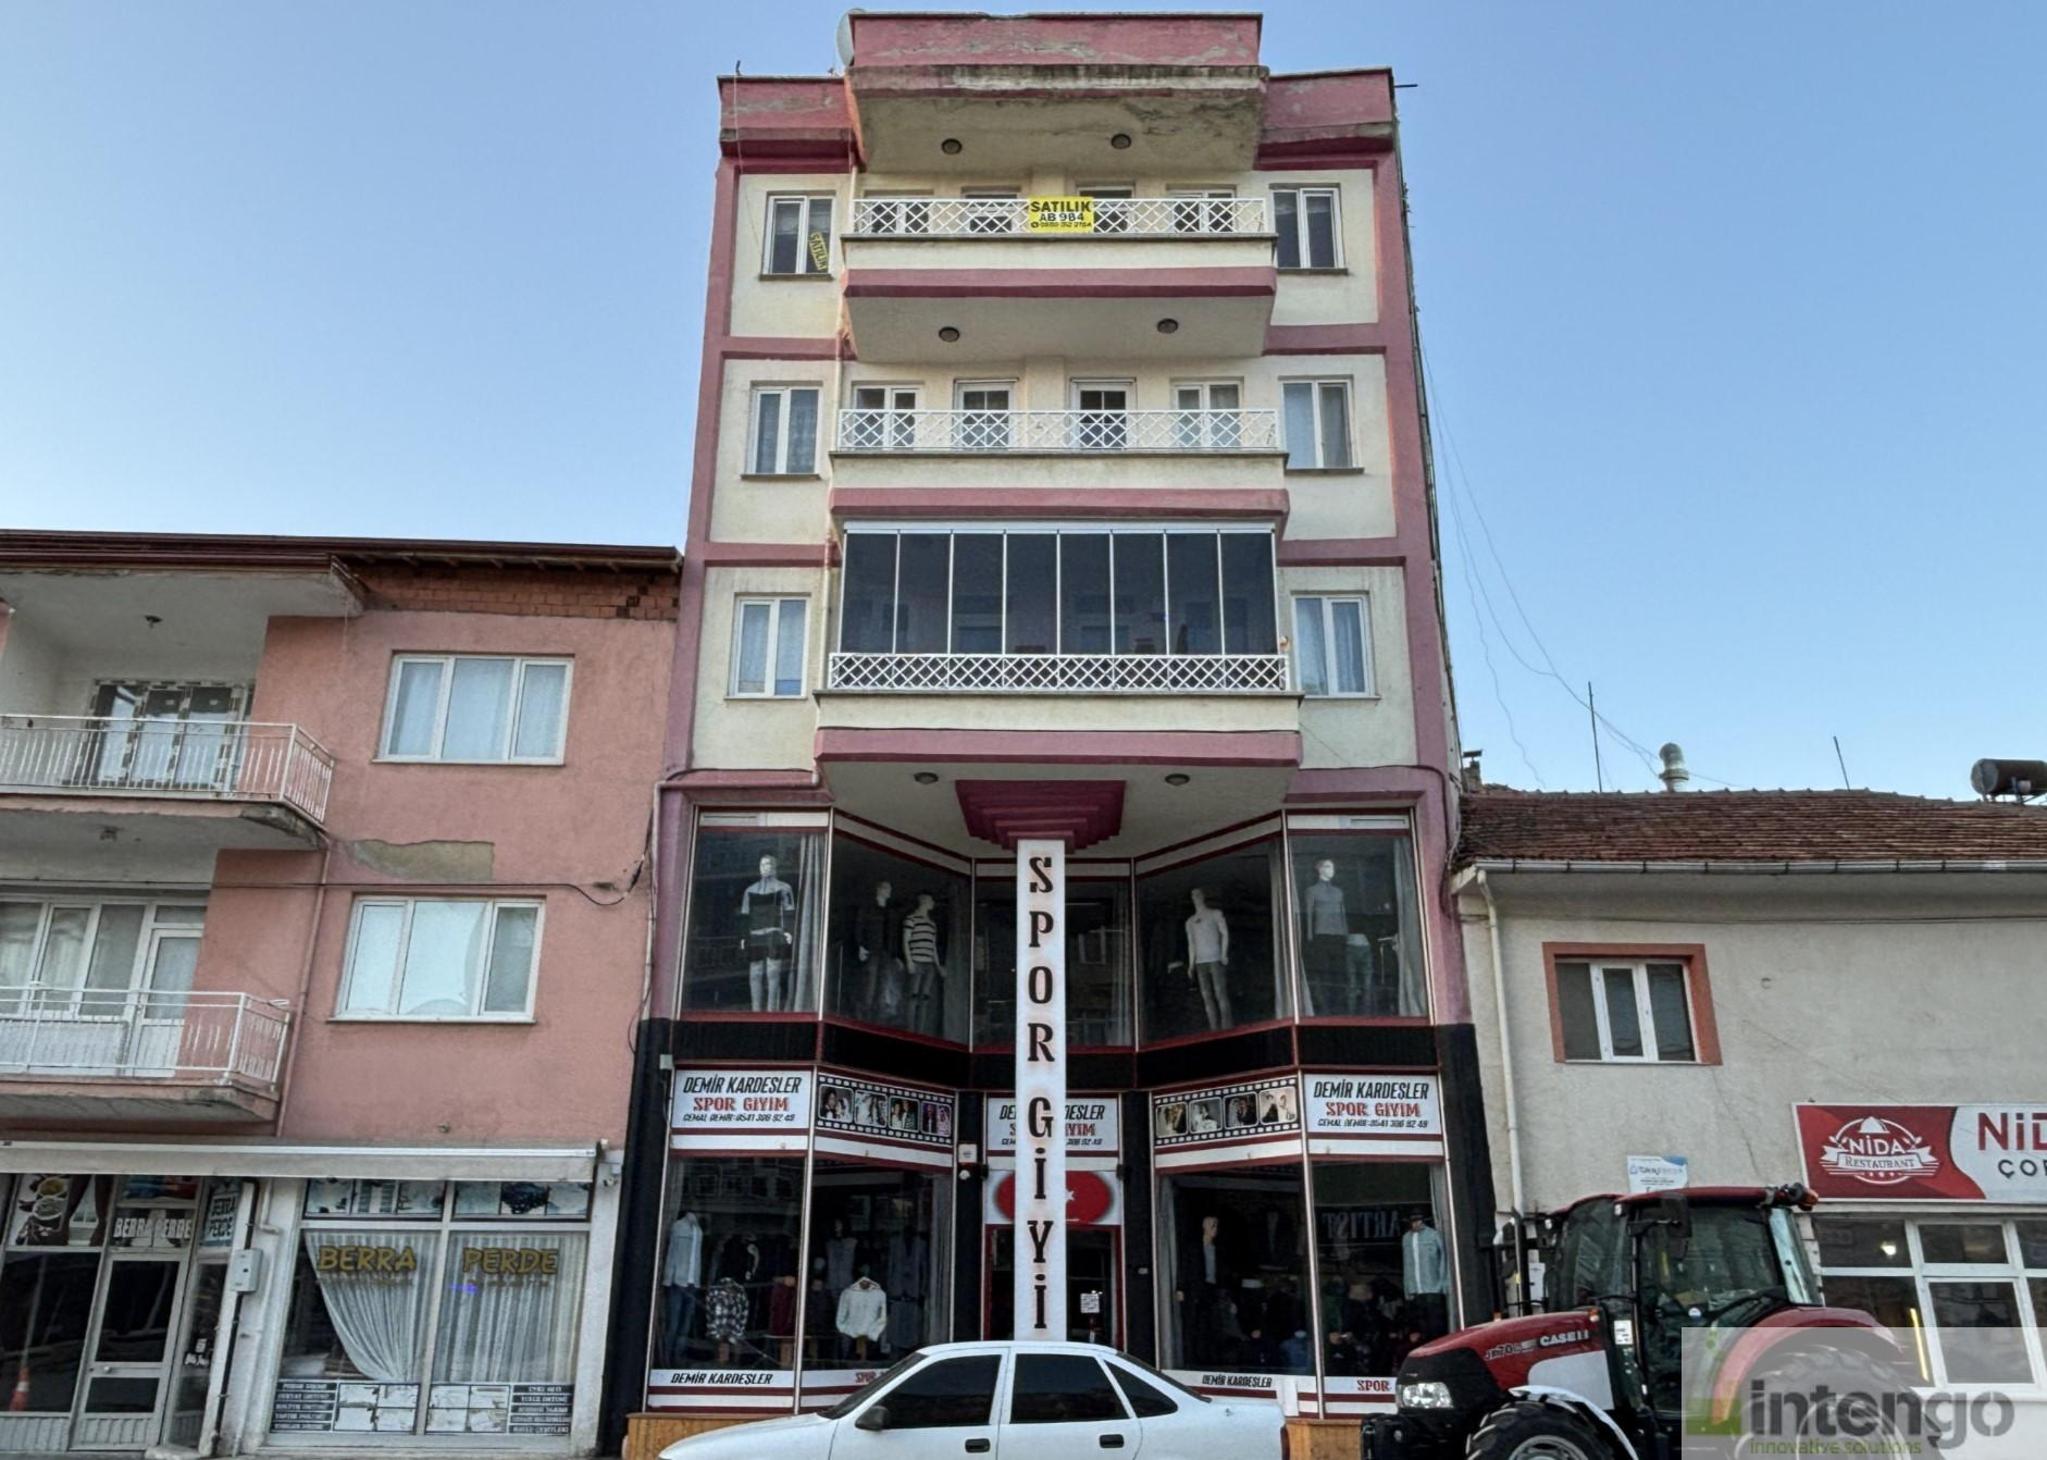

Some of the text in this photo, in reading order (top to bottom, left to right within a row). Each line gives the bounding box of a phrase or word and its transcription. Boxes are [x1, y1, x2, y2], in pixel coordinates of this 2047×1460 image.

[1030, 200, 1091, 212] SATILIK
[1040, 212, 1056, 221] AB
[683, 1074, 724, 1093] DEMİR
[1314, 1079, 1353, 1098] DEMİR
[1027, 857, 1055, 1329] SPOR GİYİ
[693, 1097, 736, 1111] SPOR
[1326, 1102, 1369, 1117] SPOR
[1998, 1159, 2047, 1179] ÇO
[113, 1217, 152, 1238] BERRA
[317, 1245, 558, 1275] BERRA PERDE
[671, 1372, 707, 1384] DEMİR
[1357, 1379, 1391, 1392] SPOR
